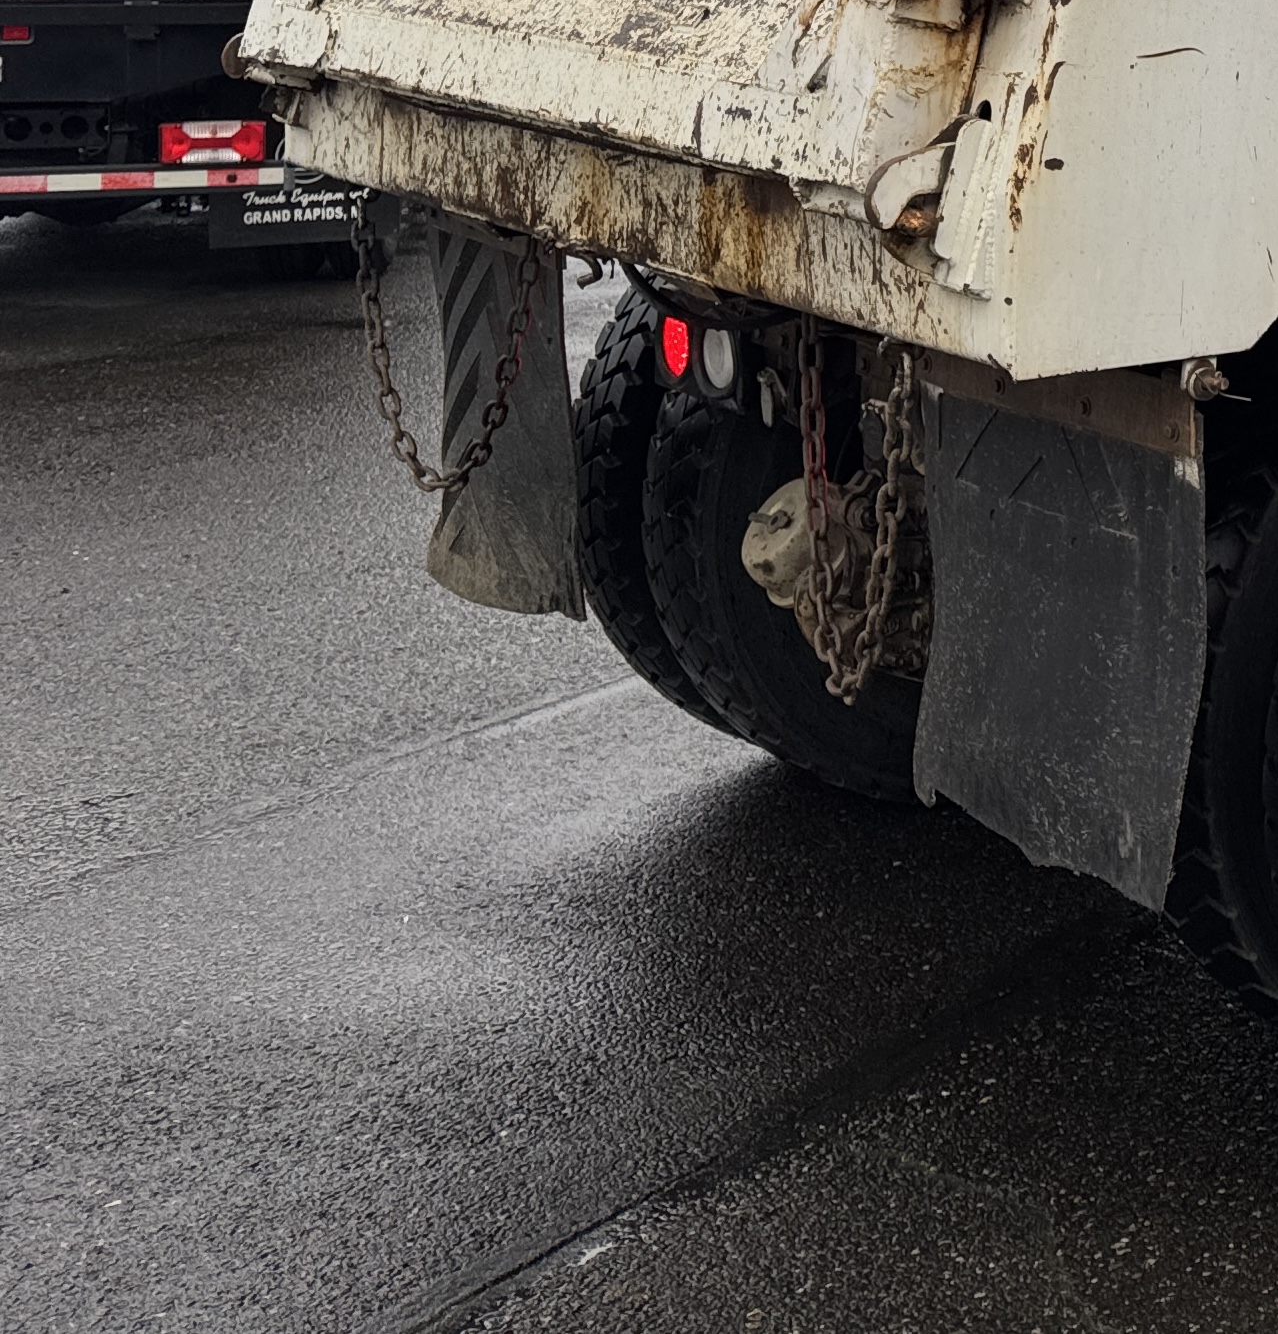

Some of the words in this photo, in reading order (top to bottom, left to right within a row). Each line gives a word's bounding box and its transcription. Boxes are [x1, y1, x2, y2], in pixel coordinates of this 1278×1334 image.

[242, 190, 287, 207] Truck
[243, 208, 292, 225] GRAND
[293, 206, 348, 222] RAPIDS,
